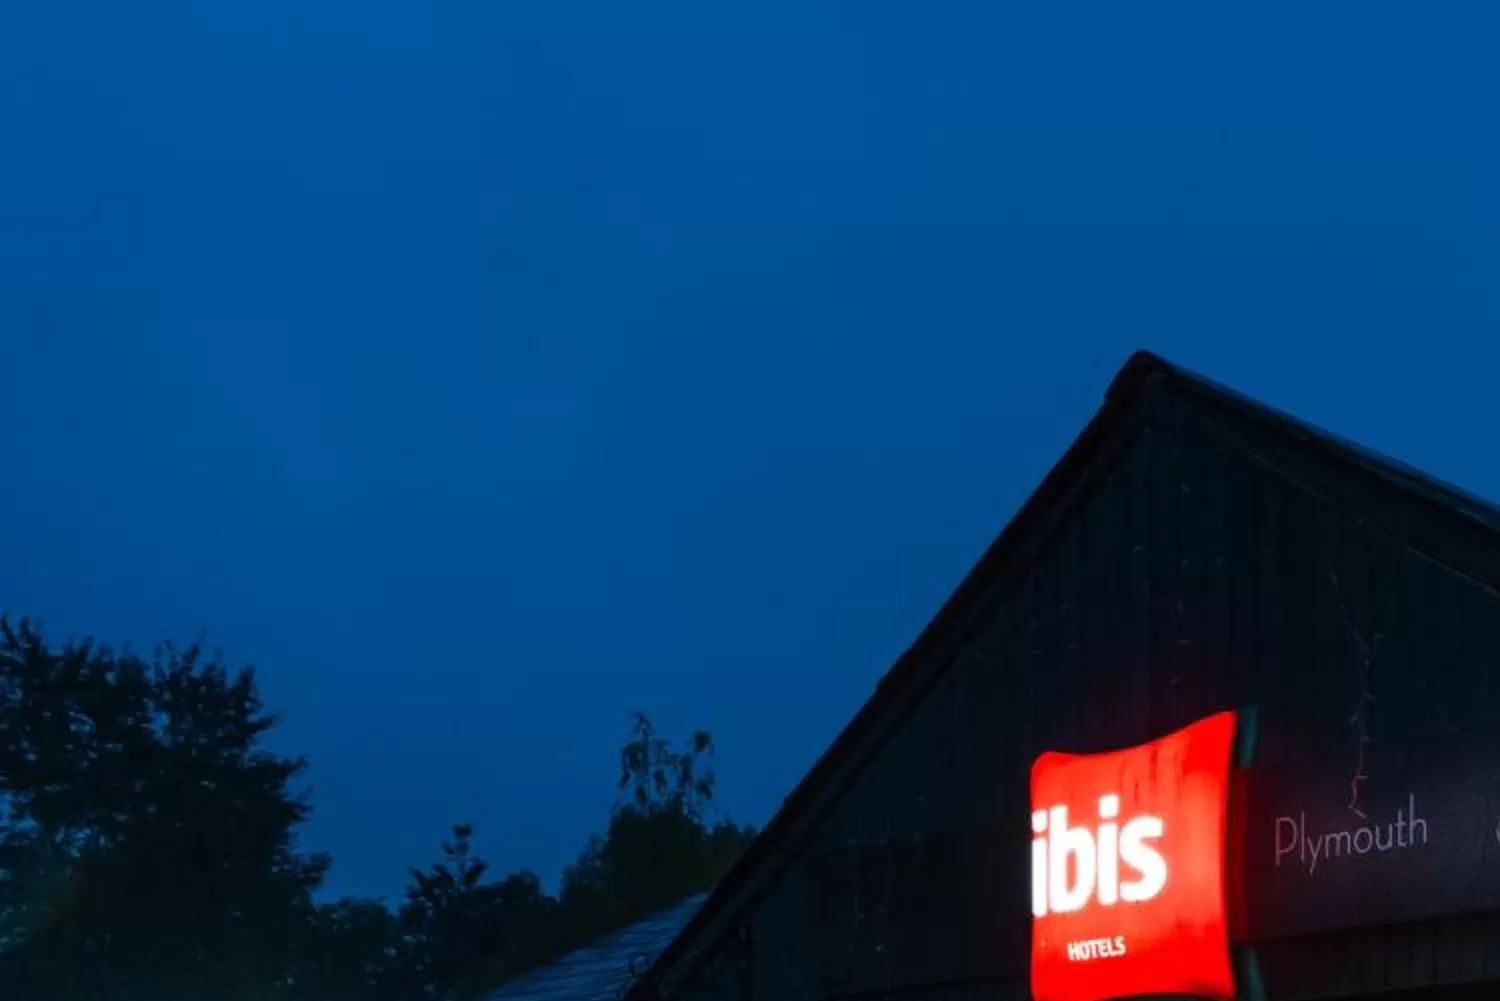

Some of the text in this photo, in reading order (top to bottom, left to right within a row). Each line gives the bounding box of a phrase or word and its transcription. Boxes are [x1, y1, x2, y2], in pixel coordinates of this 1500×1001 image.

[1031, 793, 1168, 918] ibis
[1275, 792, 1429, 876] Plymouth
[1067, 936, 1126, 961] HOTELS
